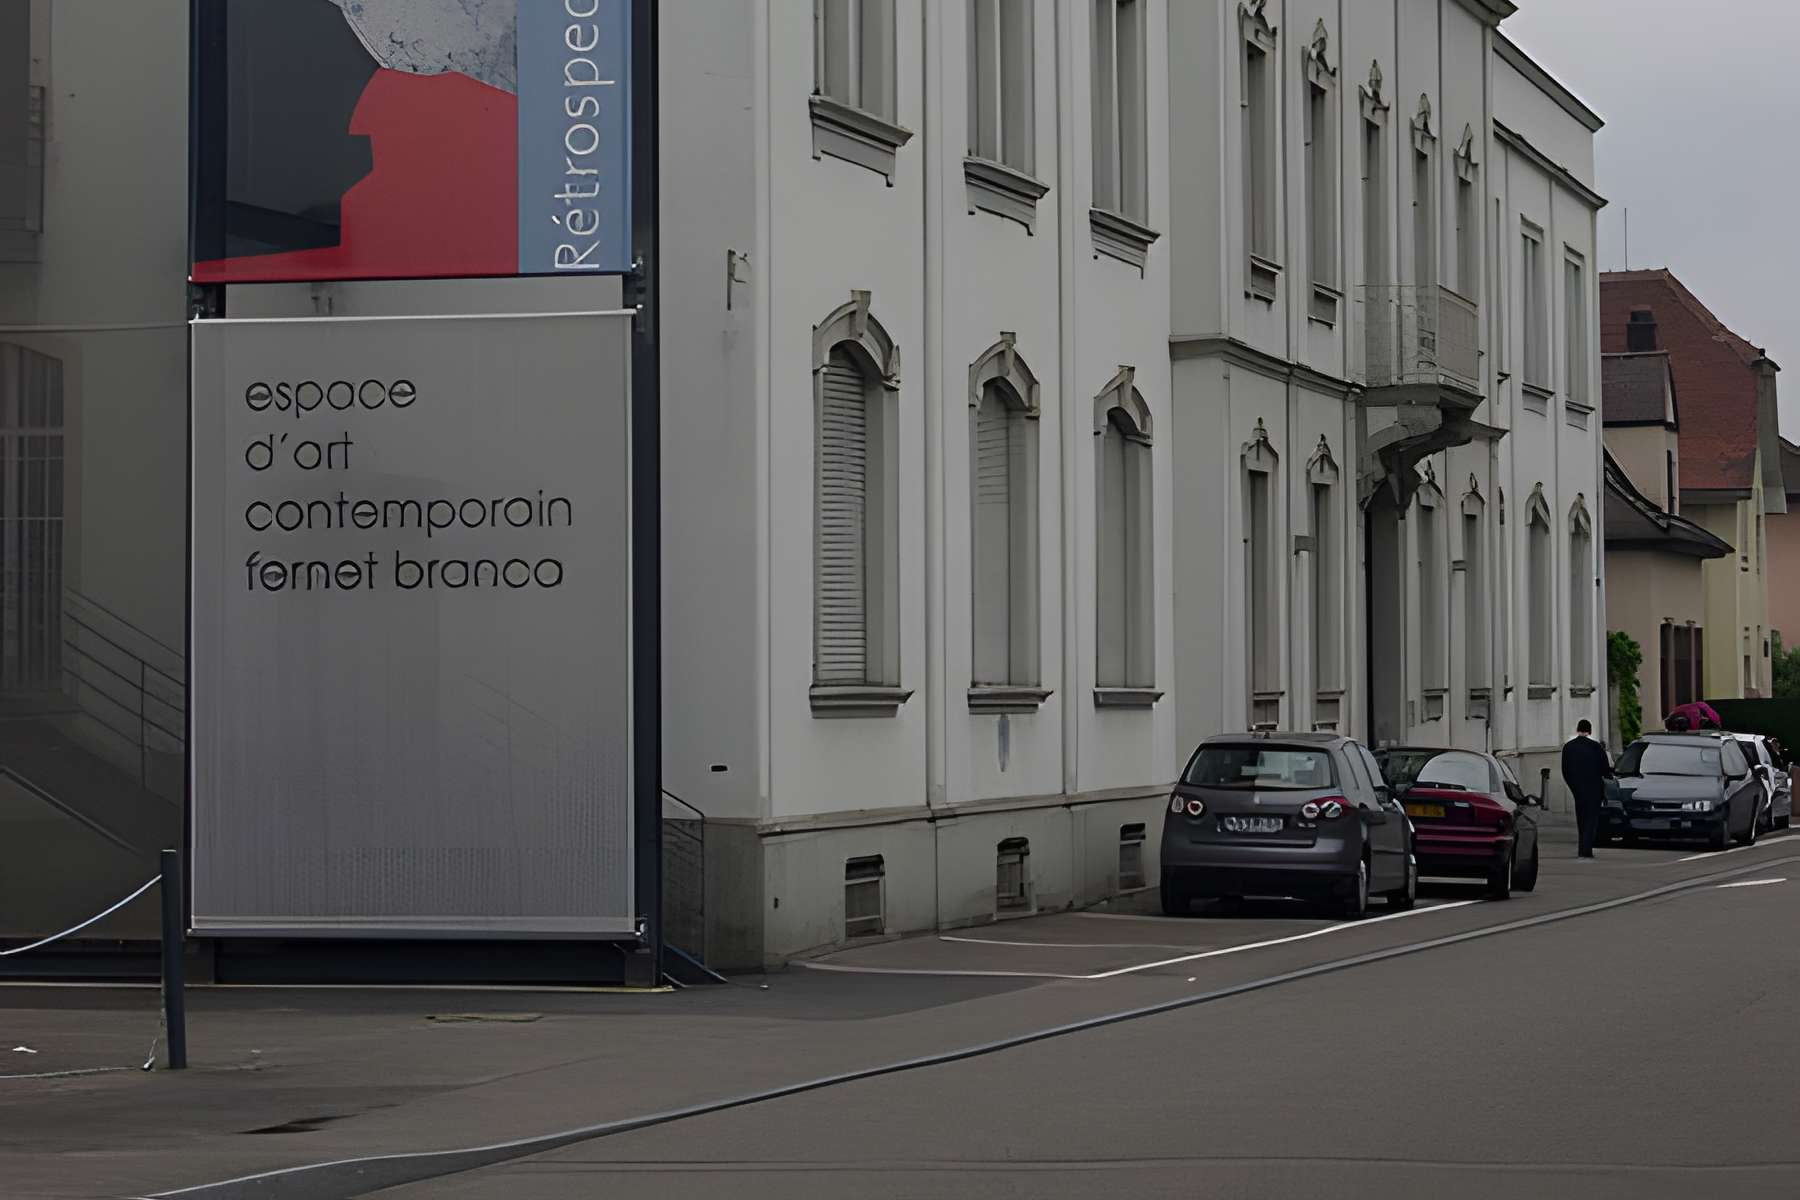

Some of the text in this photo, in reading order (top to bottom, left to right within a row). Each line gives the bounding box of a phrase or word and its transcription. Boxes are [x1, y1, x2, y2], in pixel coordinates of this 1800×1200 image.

[244, 379, 417, 419] espace
[244, 489, 573, 538] contemporain
[245, 549, 565, 592] fernet branca
